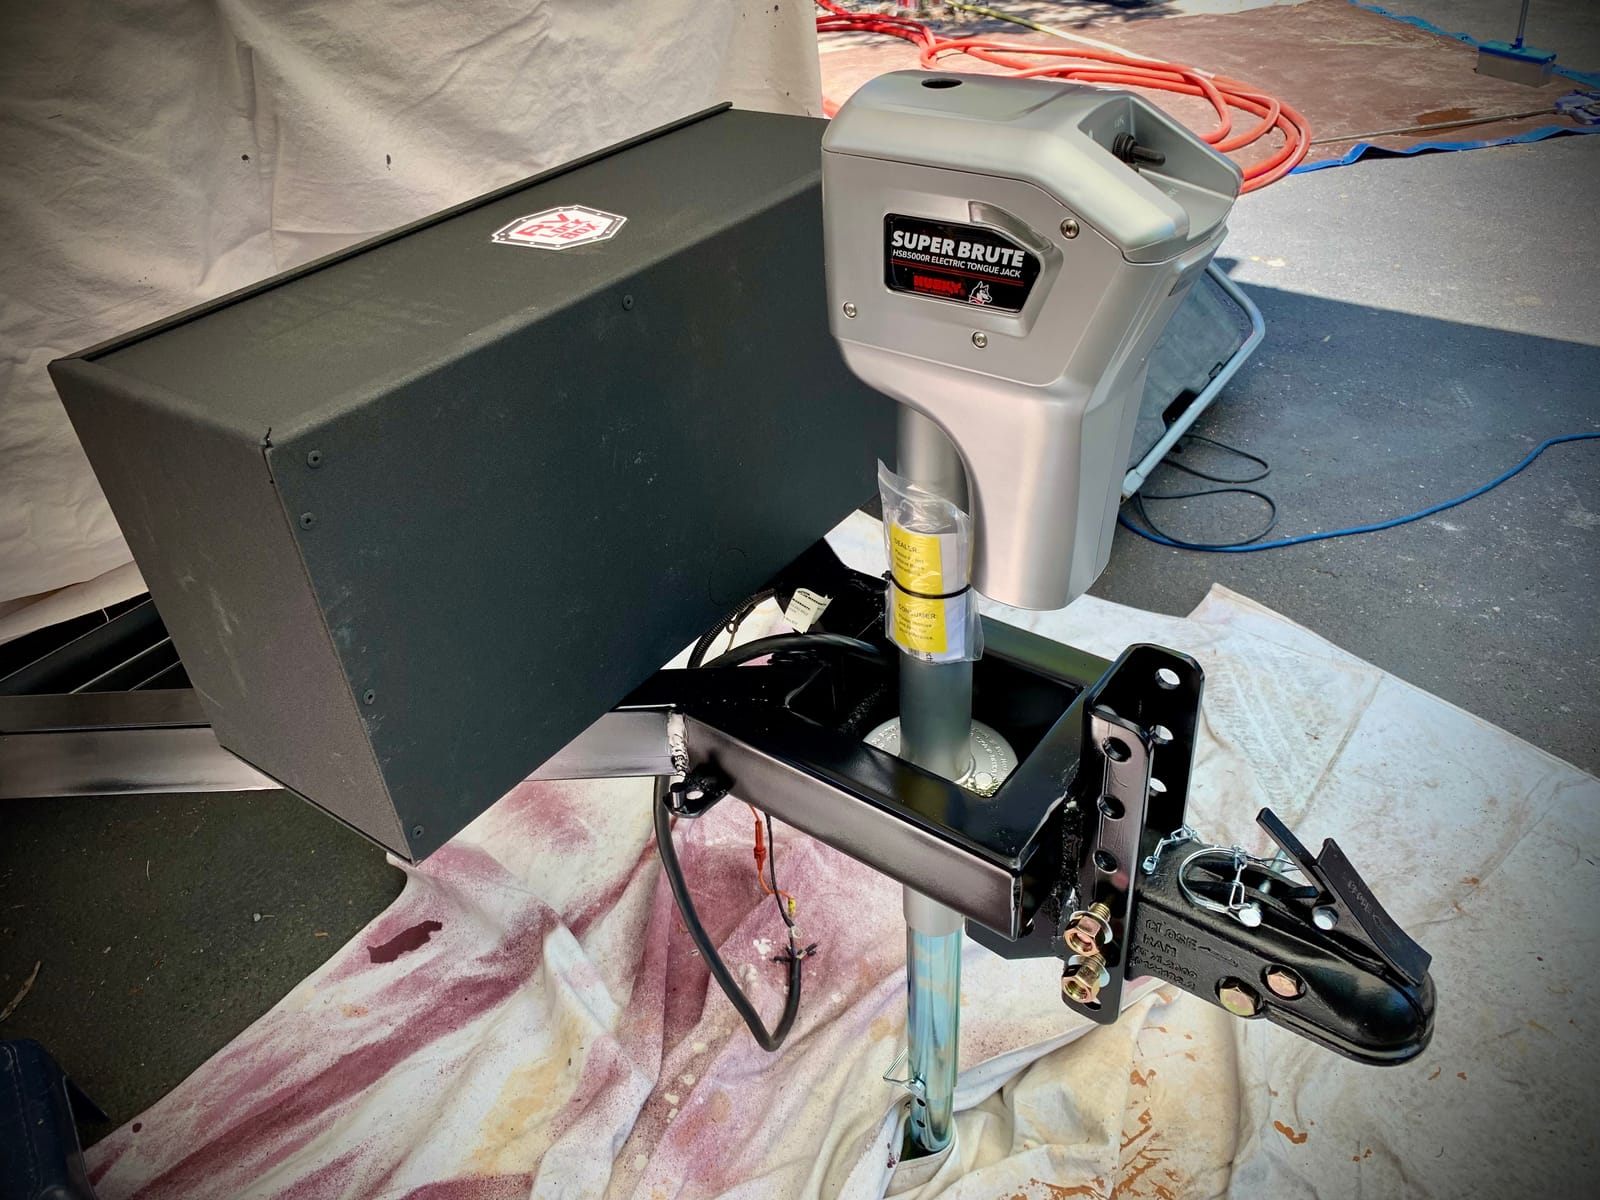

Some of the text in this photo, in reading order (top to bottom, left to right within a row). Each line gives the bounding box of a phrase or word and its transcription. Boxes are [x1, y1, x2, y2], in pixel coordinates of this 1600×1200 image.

[515, 213, 570, 236] RV
[538, 218, 592, 238] LOCK
[558, 223, 600, 240] BOX
[891, 230, 1026, 268] SUPER BRUTE
[892, 249, 1022, 278] HSB5000R ELECTRIC TONGUE JACK
[913, 275, 962, 295] HUSKY
